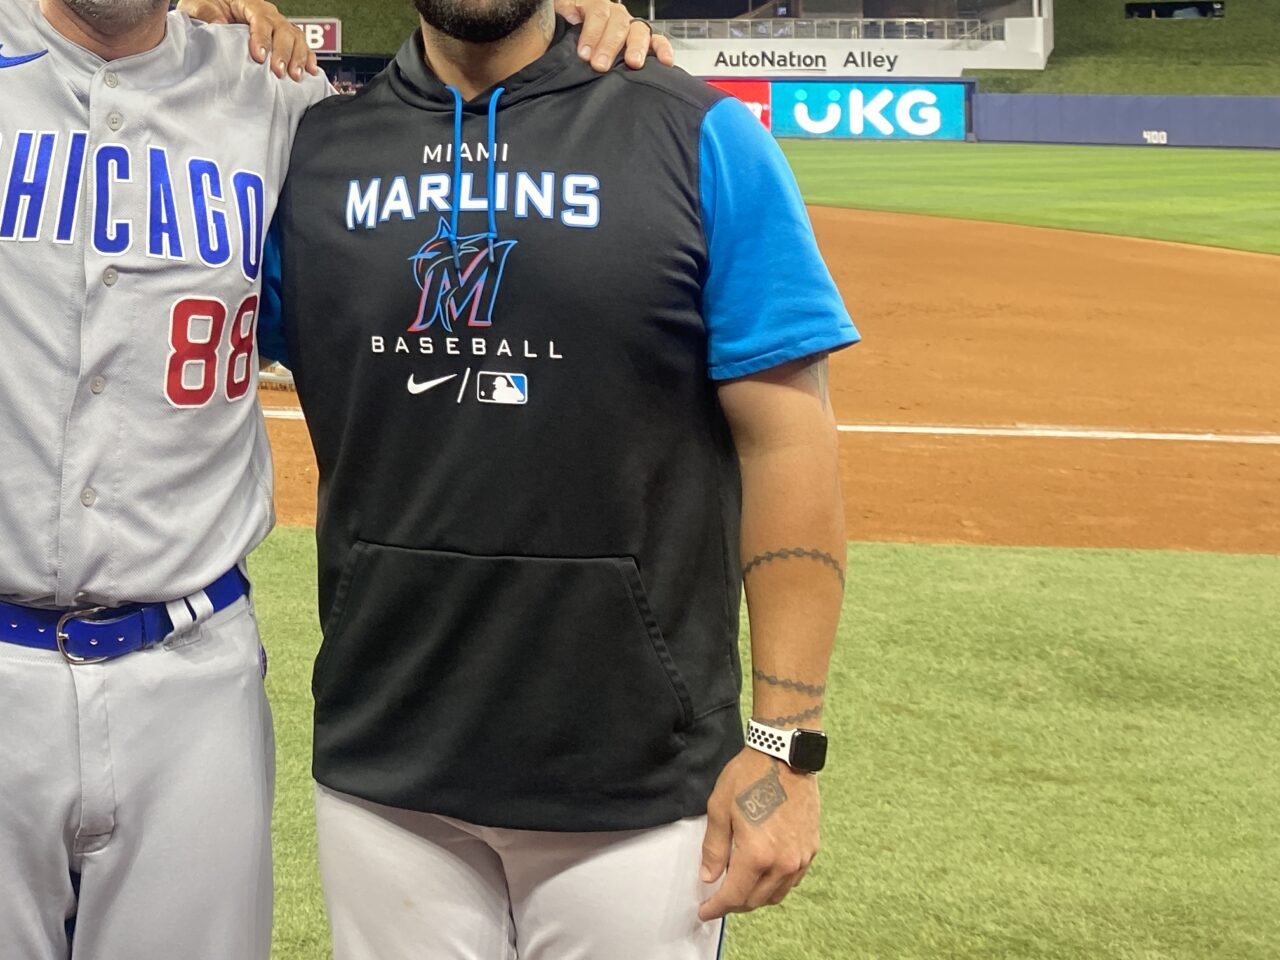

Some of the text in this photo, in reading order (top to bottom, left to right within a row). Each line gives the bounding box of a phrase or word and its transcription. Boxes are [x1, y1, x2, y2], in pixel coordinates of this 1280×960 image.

[715, 50, 898, 72] AutoNation Alley
[1142, 130, 1167, 144] 400
[423, 142, 508, 164] MIAMI
[345, 171, 600, 230] MARLINS
[164, 293, 259, 409] 88
[371, 336, 563, 359] BASEBALL
